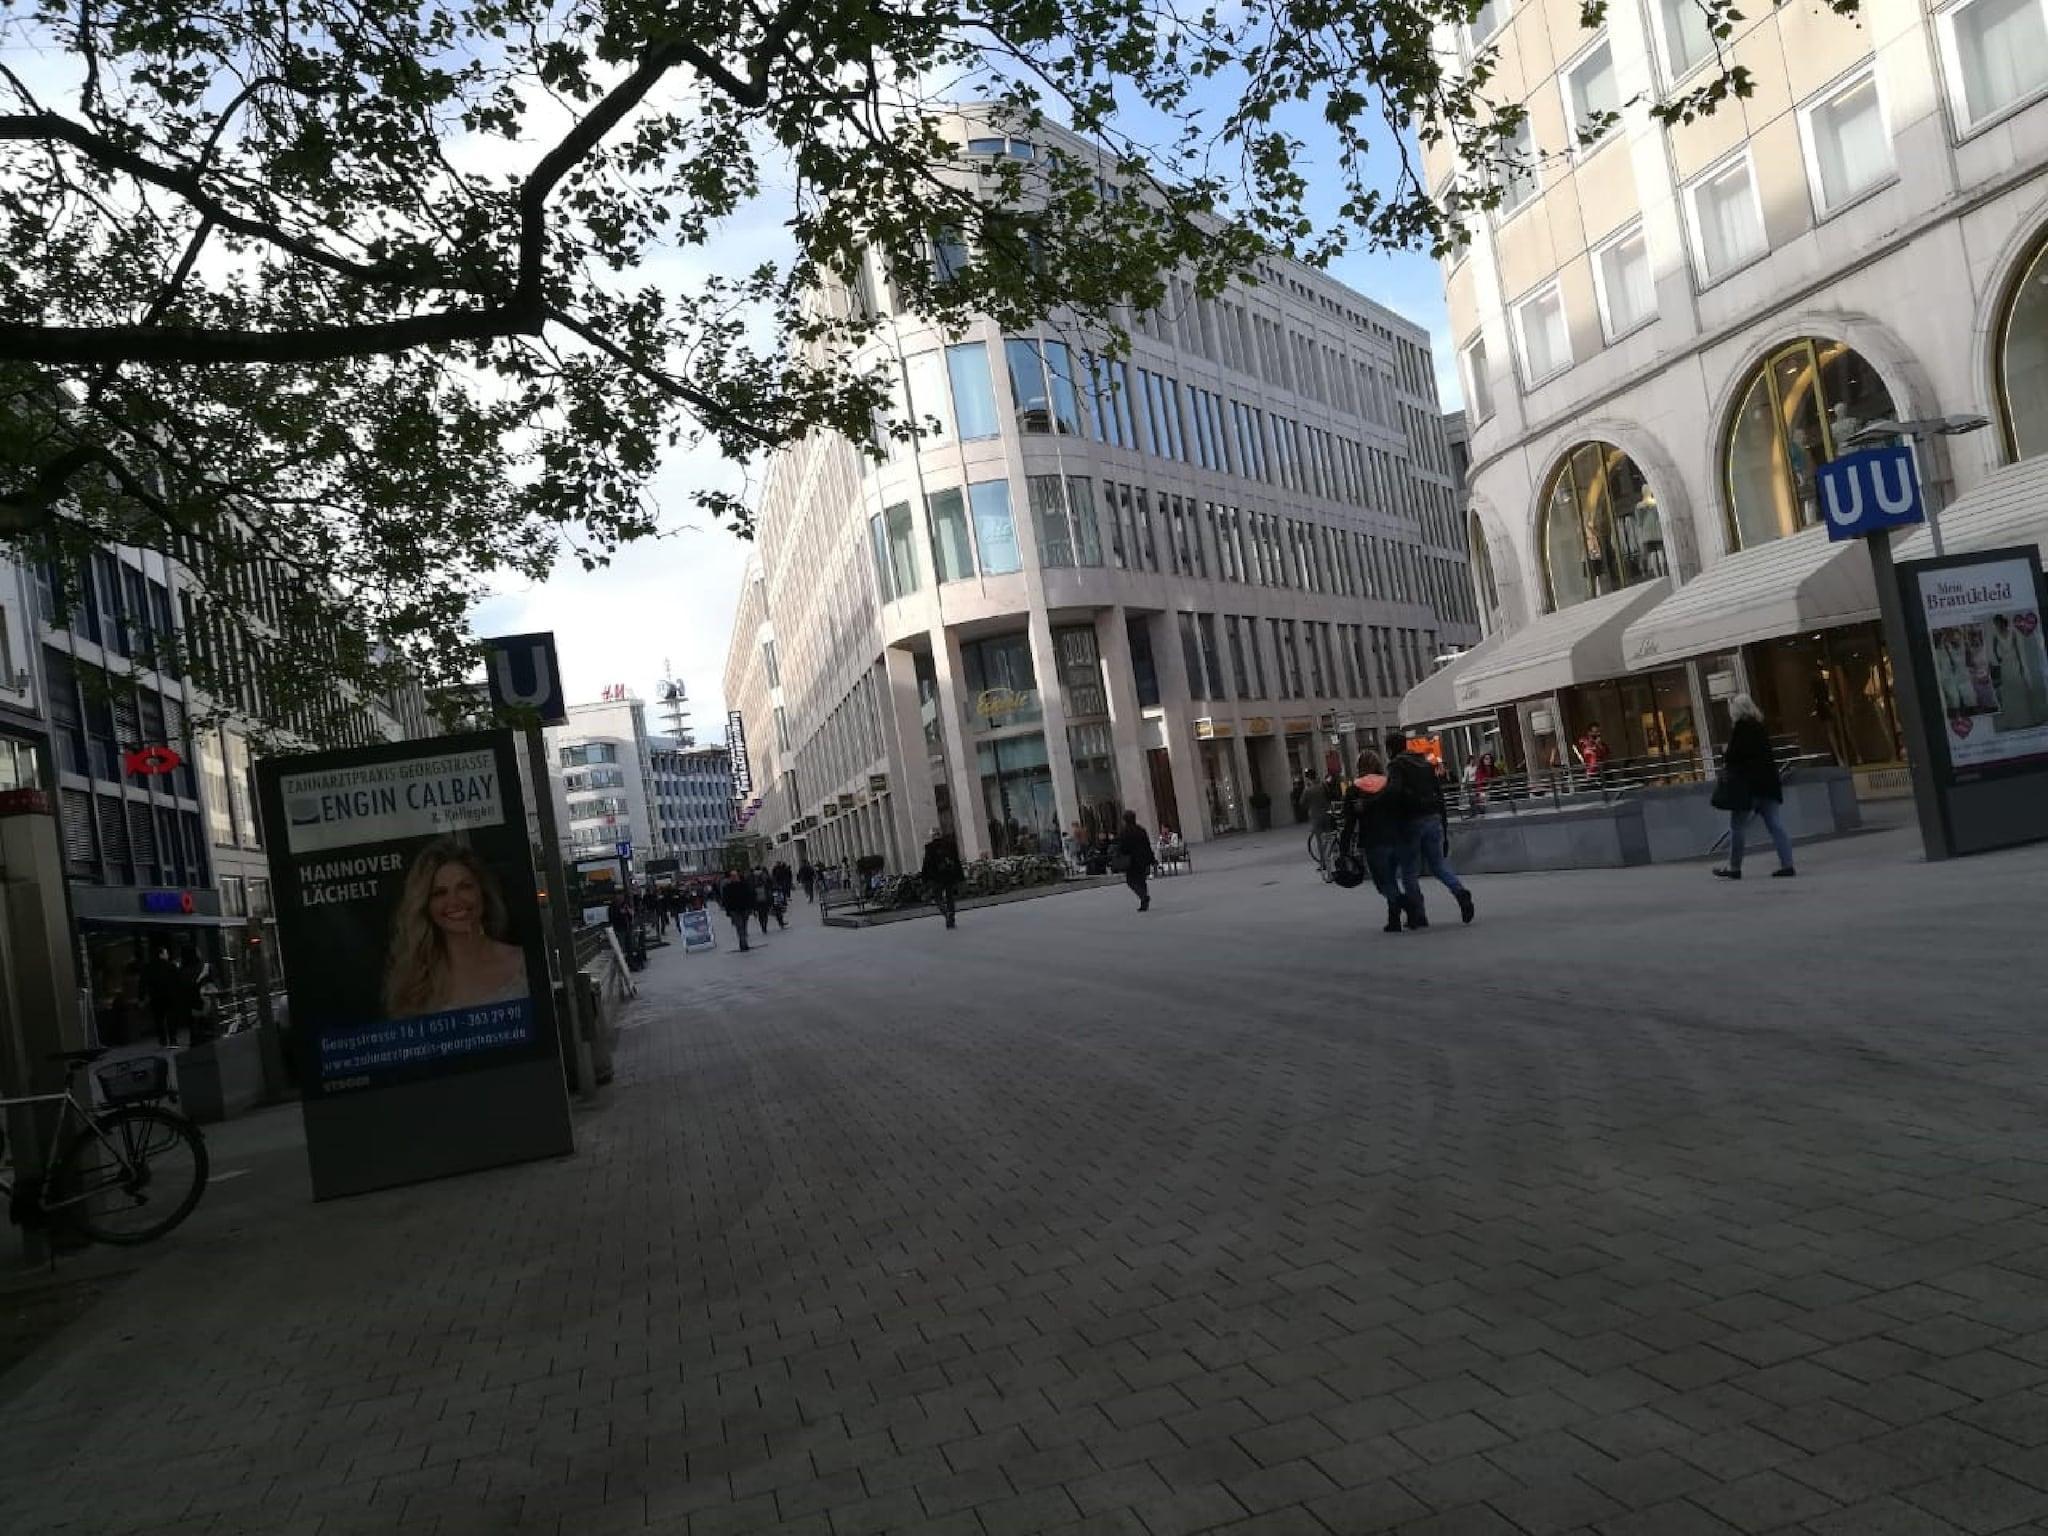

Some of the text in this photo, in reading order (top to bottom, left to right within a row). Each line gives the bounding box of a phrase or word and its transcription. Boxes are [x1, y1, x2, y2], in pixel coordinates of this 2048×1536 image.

[1926, 583, 2012, 609] Brautkleid
[1937, 581, 1962, 594] Mein
[495, 645, 551, 706] U
[287, 754, 489, 794] ZAHNARZTPRAXIS GEORGSTRASSE
[320, 773, 493, 822] ENGIN CALBAY
[299, 853, 402, 884] HANNOVER
[302, 880, 379, 907] LÄCHELT
